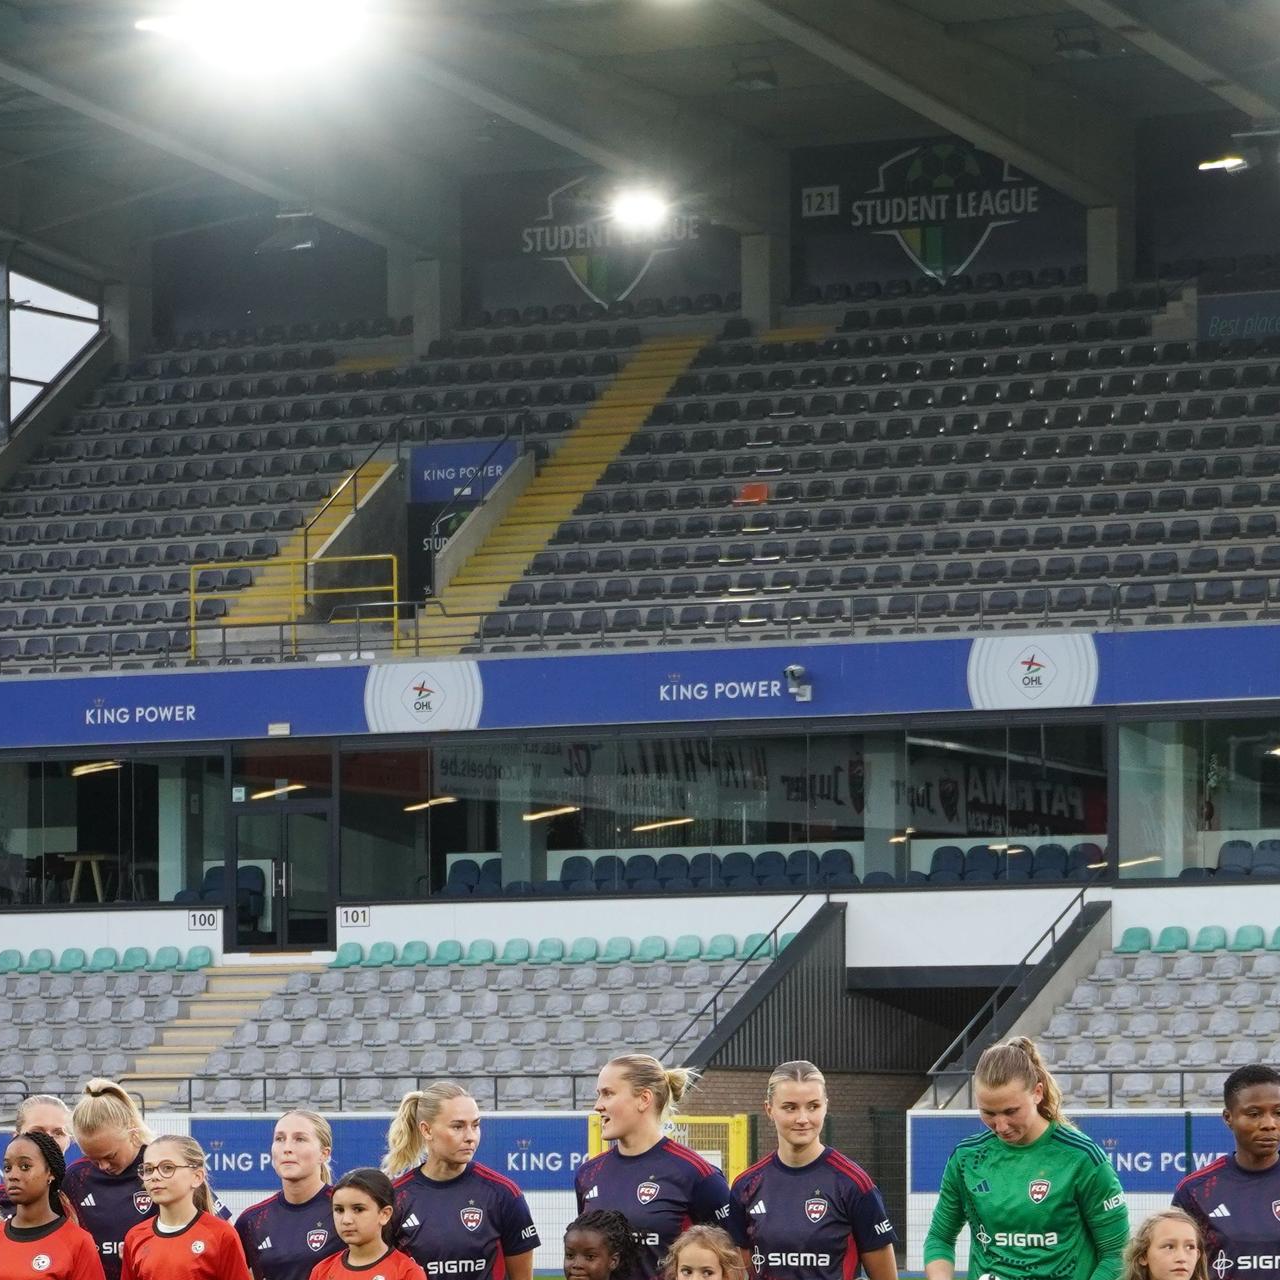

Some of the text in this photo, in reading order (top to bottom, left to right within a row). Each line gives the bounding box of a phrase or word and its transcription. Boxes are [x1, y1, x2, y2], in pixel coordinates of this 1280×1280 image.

[850, 186, 1039, 227] STUDENT LEAGUE
[423, 468, 456, 482] KING
[423, 535, 450, 552] STUD
[1021, 675, 1043, 687] OHL
[659, 680, 781, 701] KING POWER
[413, 700, 432, 711] OHL
[85, 704, 196, 725] KING POWER
[191, 912, 216, 927] 100
[343, 909, 367, 924] 101
[507, 1151, 563, 1172] KING
[1114, 1151, 1153, 1172] ING
[640, 1187, 655, 1196] FCR
[1030, 1184, 1048, 1193] FCR
[136, 1196, 151, 1204] FCR
[807, 1203, 825, 1213] FCR
[463, 1212, 480, 1221] FCR
[309, 1233, 325, 1242] FCR
[101, 1241, 124, 1255] SIG
